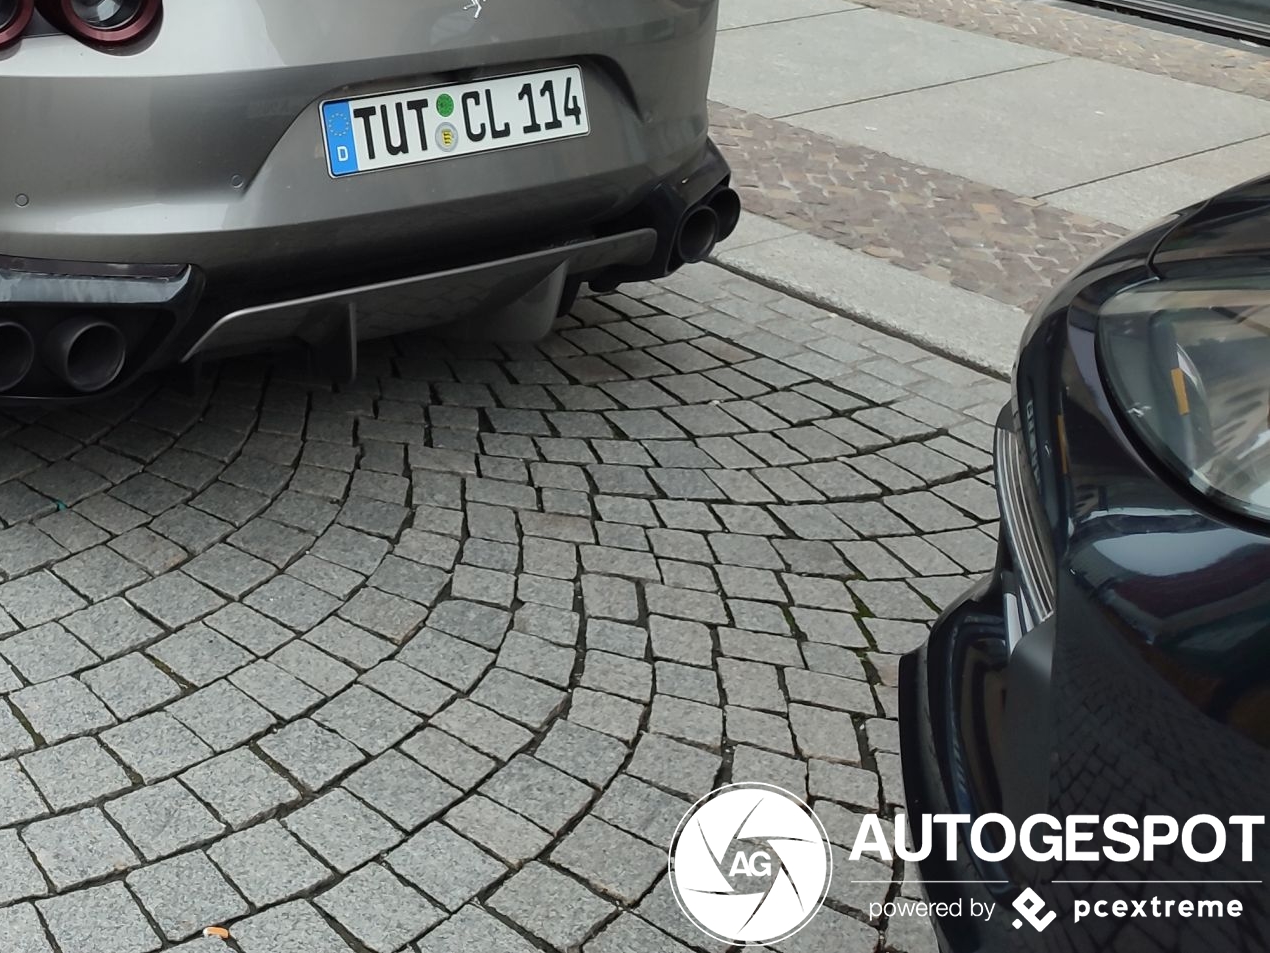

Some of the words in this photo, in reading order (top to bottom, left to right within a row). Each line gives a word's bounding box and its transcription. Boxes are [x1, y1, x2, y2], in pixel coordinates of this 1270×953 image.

[353, 98, 429, 160] TUT
[461, 88, 511, 142] CL
[518, 77, 582, 134] 114
[336, 146, 349, 162] D
